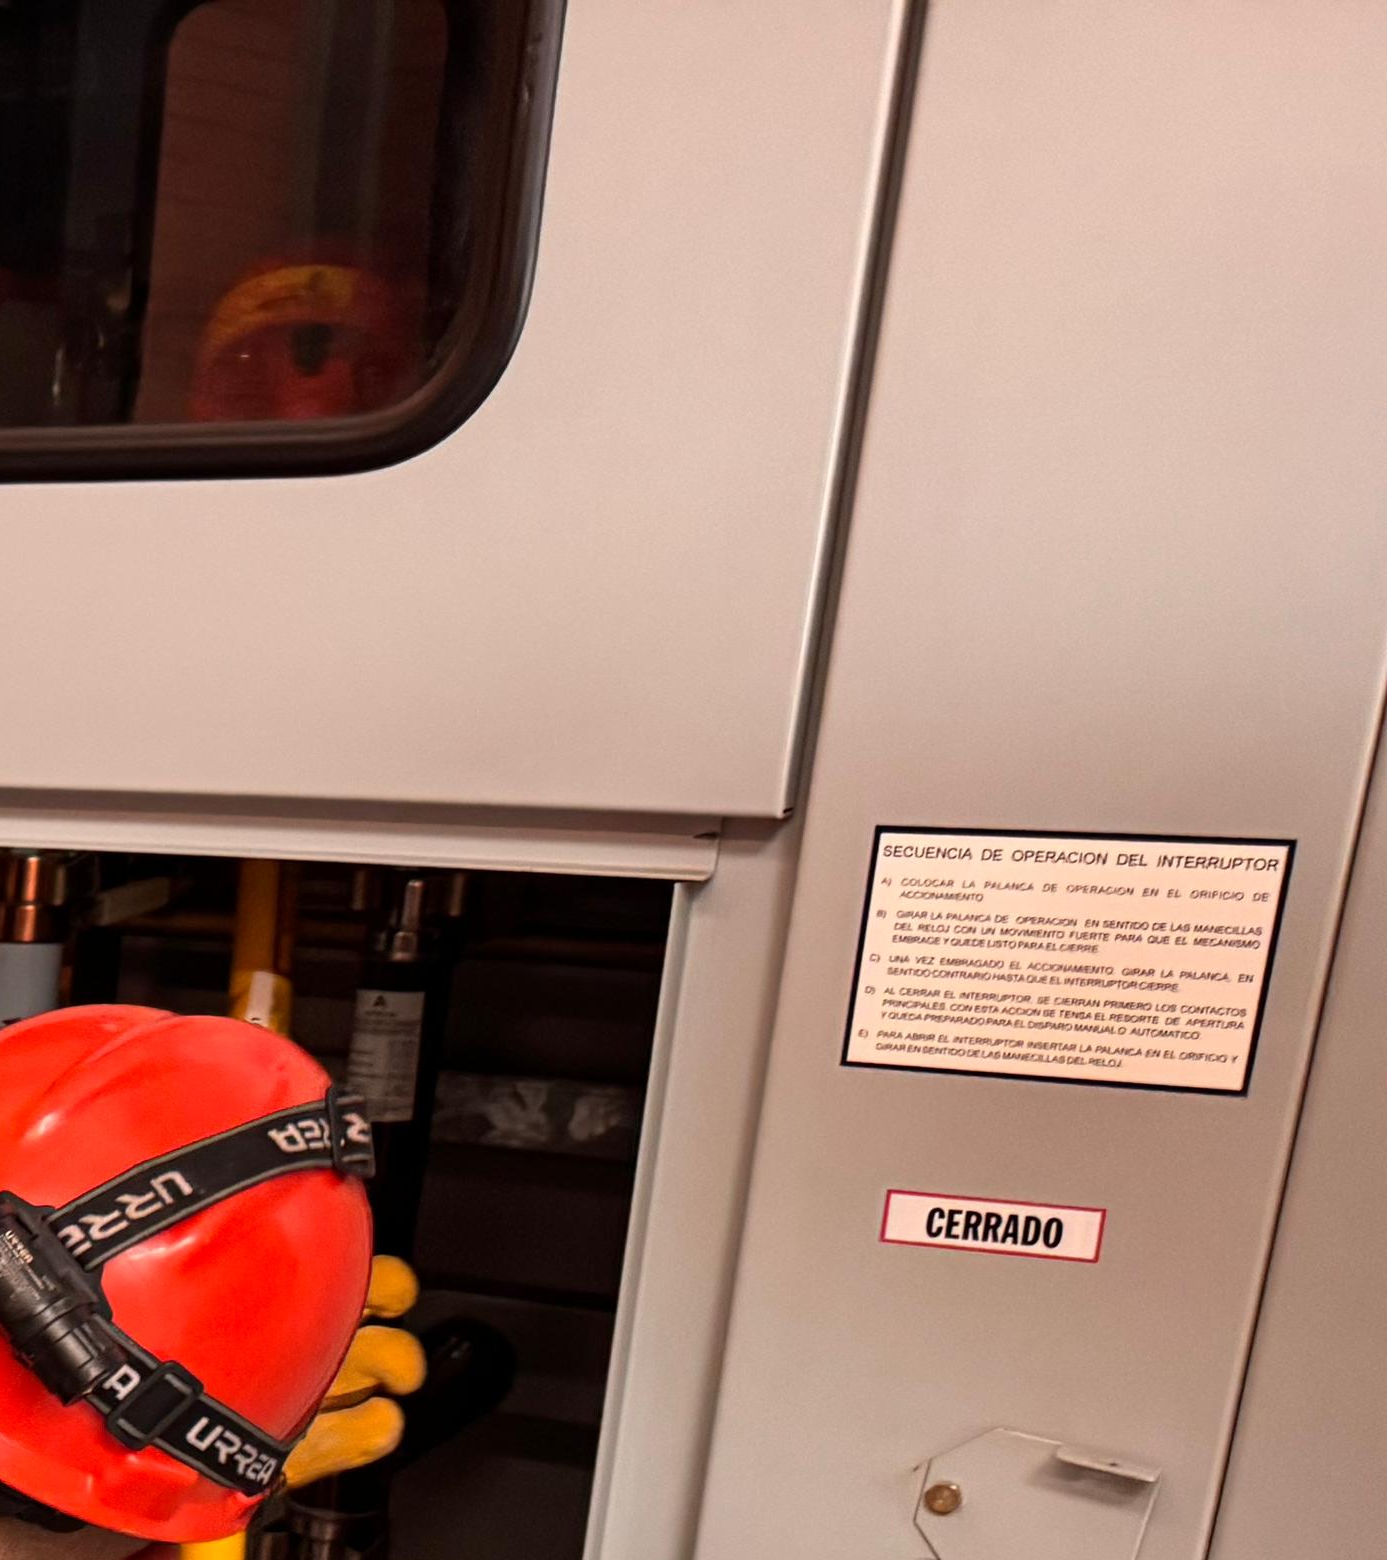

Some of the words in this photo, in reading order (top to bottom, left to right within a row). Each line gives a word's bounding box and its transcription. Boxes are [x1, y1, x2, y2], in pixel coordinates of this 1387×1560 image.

[883, 844, 973, 861] SECUENCIA
[980, 848, 1004, 862] DE
[1011, 849, 1109, 866] OPERACION
[1116, 853, 1148, 868] DEL
[1156, 854, 1280, 872] INTERRUPTOR
[900, 877, 955, 888] COLOCAR
[961, 879, 976, 889] LA
[983, 880, 1034, 892] PALANCA
[1041, 882, 1058, 893] DE
[1066, 884, 1135, 896] OPERACION
[1141, 887, 1160, 898] EN
[1166, 888, 1182, 899] EL
[1189, 889, 1245, 902] ORIFICIO
[1252, 891, 1270, 903] DE
[893, 921, 913, 932] DEL
[917, 923, 951, 934] RELOJ
[953, 924, 977, 935] CON
[980, 927, 997, 936] UN
[999, 927, 1066, 940] MOVIMIENTO
[1068, 930, 1111, 942] FUERTE
[1114, 933, 1143, 944] PARA
[1146, 934, 1171, 945] QUE
[1174, 935, 1188, 946] EL
[1192, 937, 1261, 950] MECANISMO
[896, 909, 928, 920] GIRAR
[929, 911, 944, 921] LA
[945, 912, 992, 923] PALANCA
[993, 914, 1010, 925] DE
[1015, 915, 1078, 928] OPERACION
[1084, 918, 1100, 929] EN
[1102, 919, 1150, 931] SENTIDO
[1151, 922, 1168, 932] DE
[1169, 922, 1191, 933] LAS
[1193, 924, 1263, 937] MANECILLAS
[986, 939, 1017, 950] LISTO
[1017, 940, 1045, 951] PARA
[1044, 941, 1058, 952] EL
[887, 966, 932, 978] SENTIDO
[931, 969, 992, 981] CONTRARIO
[991, 972, 1026, 983] HASTA
[1025, 974, 1048, 985] QUE
[1048, 975, 1062, 986] EL
[1063, 977, 1139, 990] INTERRUPTOR
[888, 954, 911, 964] UNA
[915, 955, 936, 966] VEZ
[939, 957, 1005, 970] EMBRAGADO
[1008, 960, 1022, 971] EL
[1121, 967, 1156, 978] GIRAR
[1159, 969, 1174, 979] LA
[1237, 973, 1255, 984] EN
[883, 986, 895, 996] AL
[898, 987, 941, 998] CERRAR
[943, 989, 956, 1000] EL
[1036, 995, 1051, 1006] SE
[1053, 996, 1101, 1008] CIERRAN
[1102, 999, 1153, 1012] PRIMERO
[1154, 1003, 1178, 1013] LOS
[1179, 1004, 1247, 1018] CONTACTOS
[923, 1013, 986, 1026] PREPARADO
[985, 1017, 1013, 1028] PARA
[1013, 1018, 1026, 1029] EL
[1026, 1020, 1073, 1032] DISPARO
[1073, 1023, 1117, 1035] MANUAL
[949, 1003, 974, 1013] CON
[973, 1004, 1000, 1014] ESTA
[1000, 1006, 1042, 1017] ACCION
[1042, 1008, 1057, 1019] SE
[1059, 1009, 1092, 1021] TENSA
[1093, 1011, 1107, 1022] EL
[1164, 1016, 1182, 1027] DE
[1185, 1018, 1245, 1030] APERTURA
[875, 1042, 907, 1052] GIRAR
[906, 1044, 922, 1054] EN
[921, 1045, 967, 1057] SENTIDO
[966, 1048, 981, 1059] DE
[980, 1050, 1002, 1060] LAS
[1001, 1051, 1066, 1065] MANECILLAS
[1066, 1055, 1088, 1066] DEL
[876, 1029, 904, 1040] PARA
[904, 1032, 936, 1042] ABRIR
[937, 1033, 950, 1044] EL
[952, 1036, 1025, 1049] INTERRUPTOR
[1026, 1041, 1078, 1052] INSERTAR
[1078, 1044, 1093, 1054] LA
[1094, 1045, 1143, 1057] PALANCA
[1144, 1048, 1162, 1059] EN
[1162, 1049, 1176, 1060] EL
[1178, 1051, 1228, 1064] ORIFICIO
[58, 1170, 194, 1256] URRE
[925, 1207, 1064, 1249] CERRADO
[185, 1416, 278, 1486] URREA
